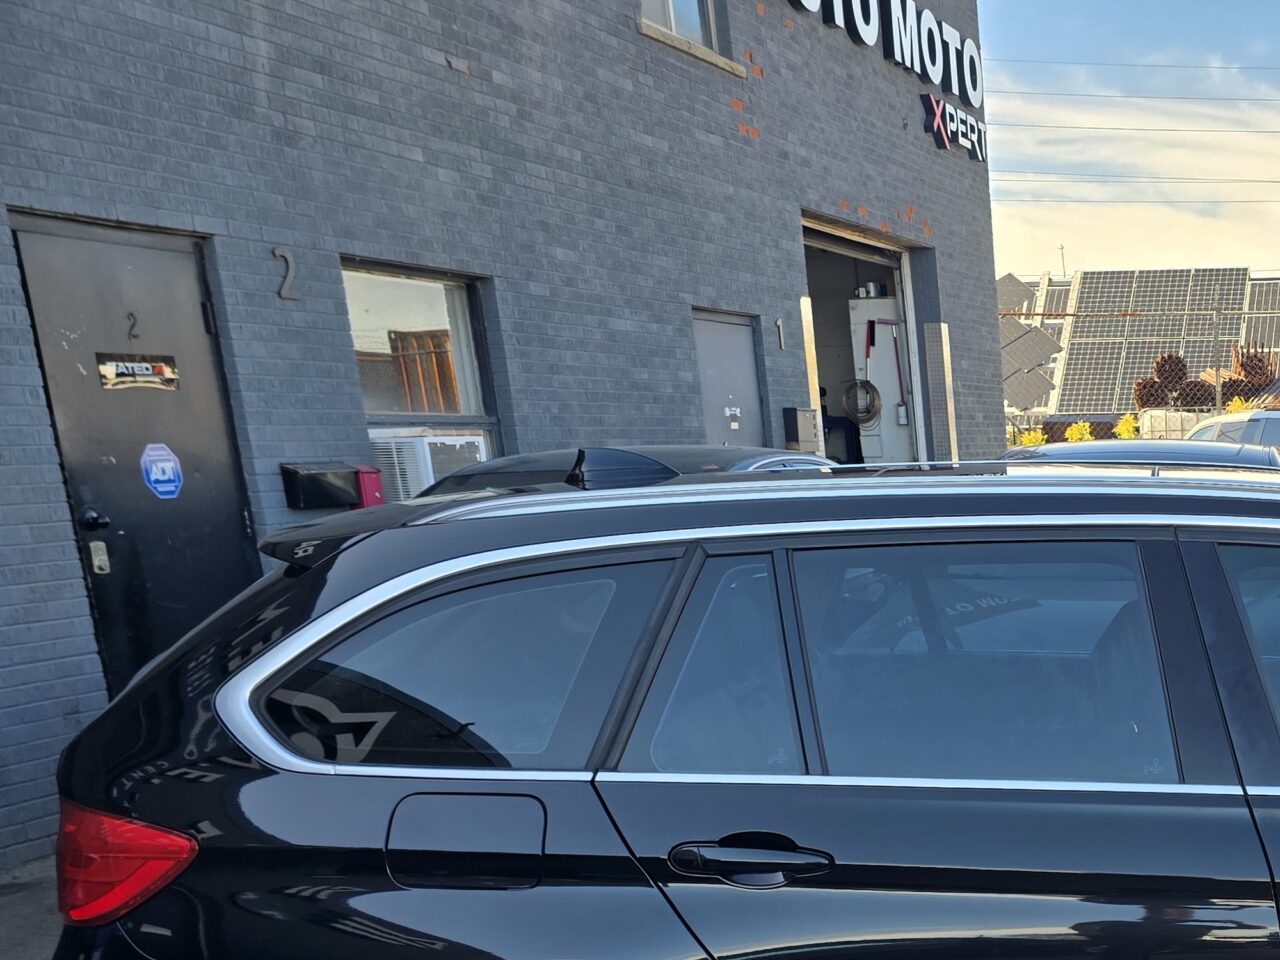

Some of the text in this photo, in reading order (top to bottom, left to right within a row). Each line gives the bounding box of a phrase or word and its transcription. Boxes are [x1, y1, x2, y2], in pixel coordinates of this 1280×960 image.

[890, 0, 984, 109] MOTO
[272, 246, 302, 301] 2
[126, 311, 140, 340] 2
[150, 462, 176, 481] ADT
